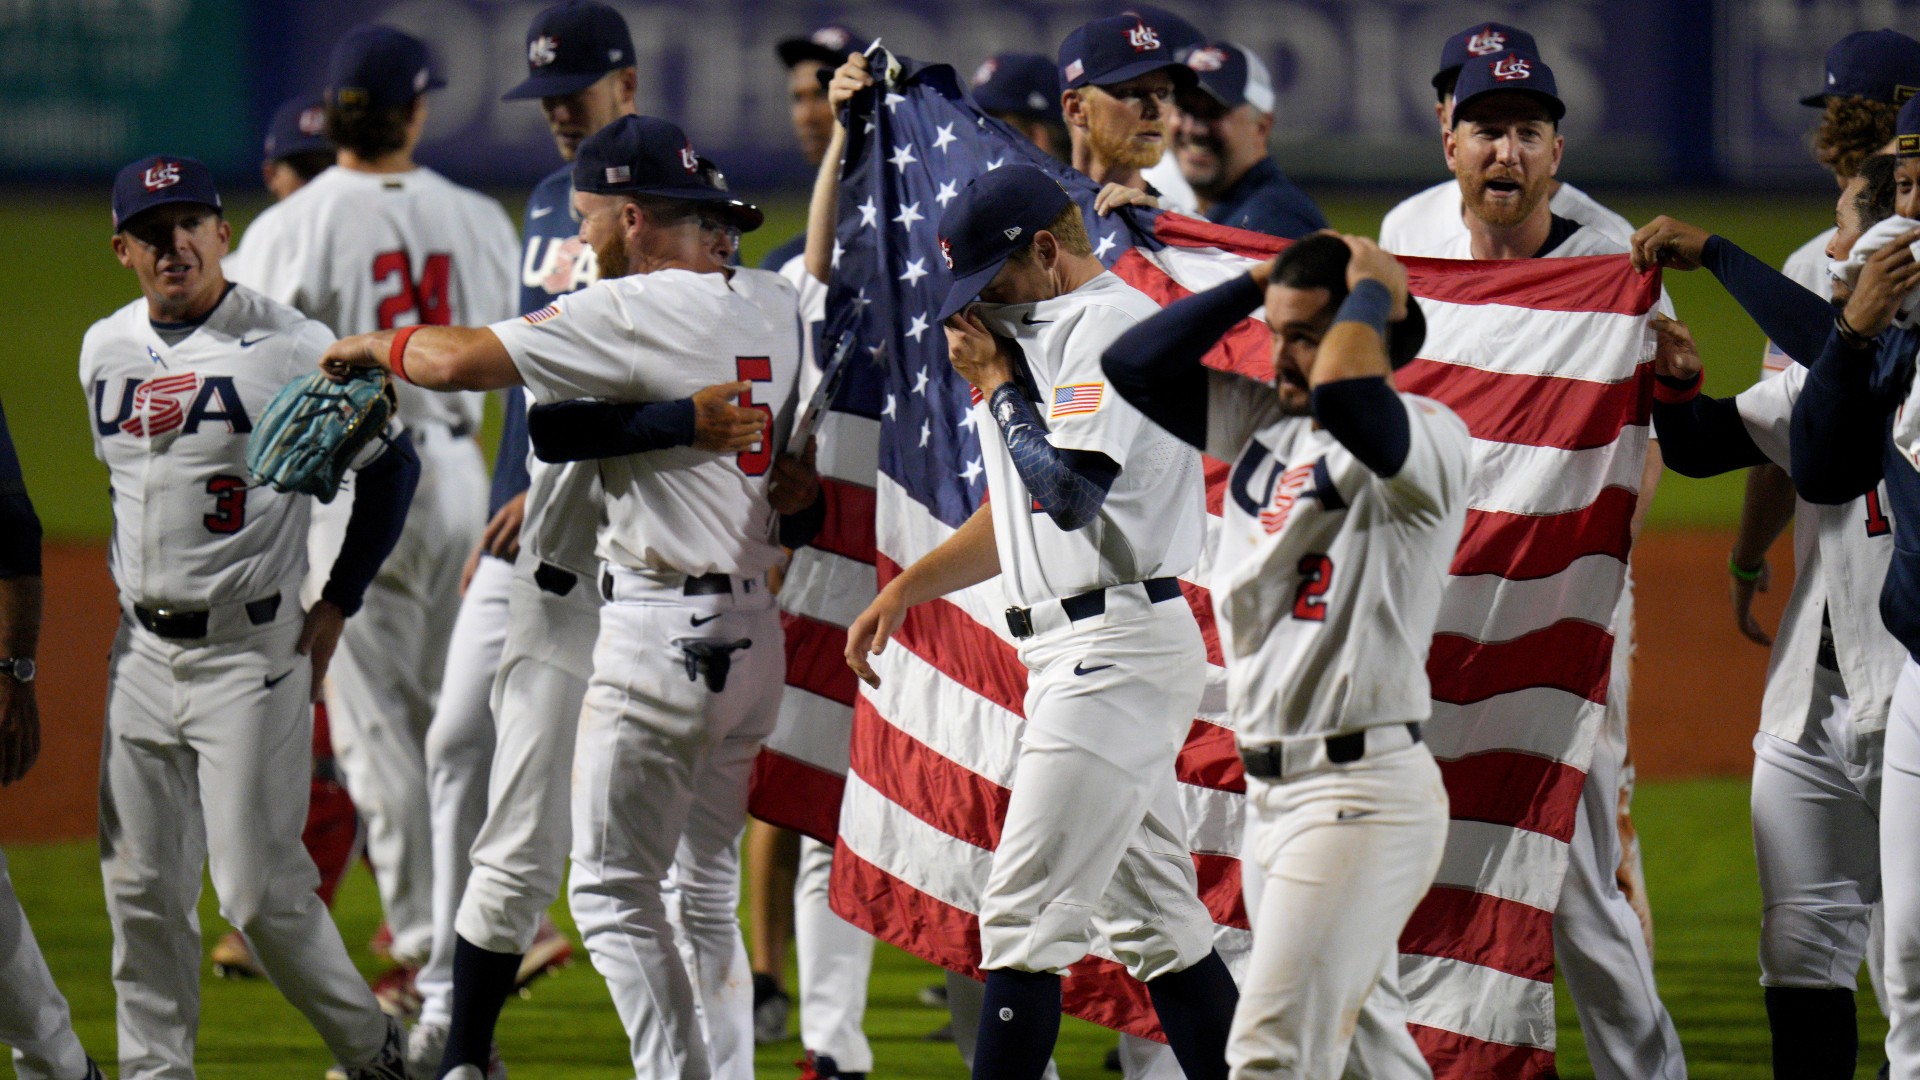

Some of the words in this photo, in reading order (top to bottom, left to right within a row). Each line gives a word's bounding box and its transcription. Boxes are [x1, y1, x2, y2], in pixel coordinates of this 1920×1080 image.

[1494, 59, 1531, 80] US
[144, 162, 181, 189] US
[372, 249, 453, 331] 24
[522, 235, 600, 294] USA
[95, 371, 253, 438] USA
[735, 355, 774, 477] 5
[203, 474, 248, 535] 3
[1291, 554, 1335, 622] 2
